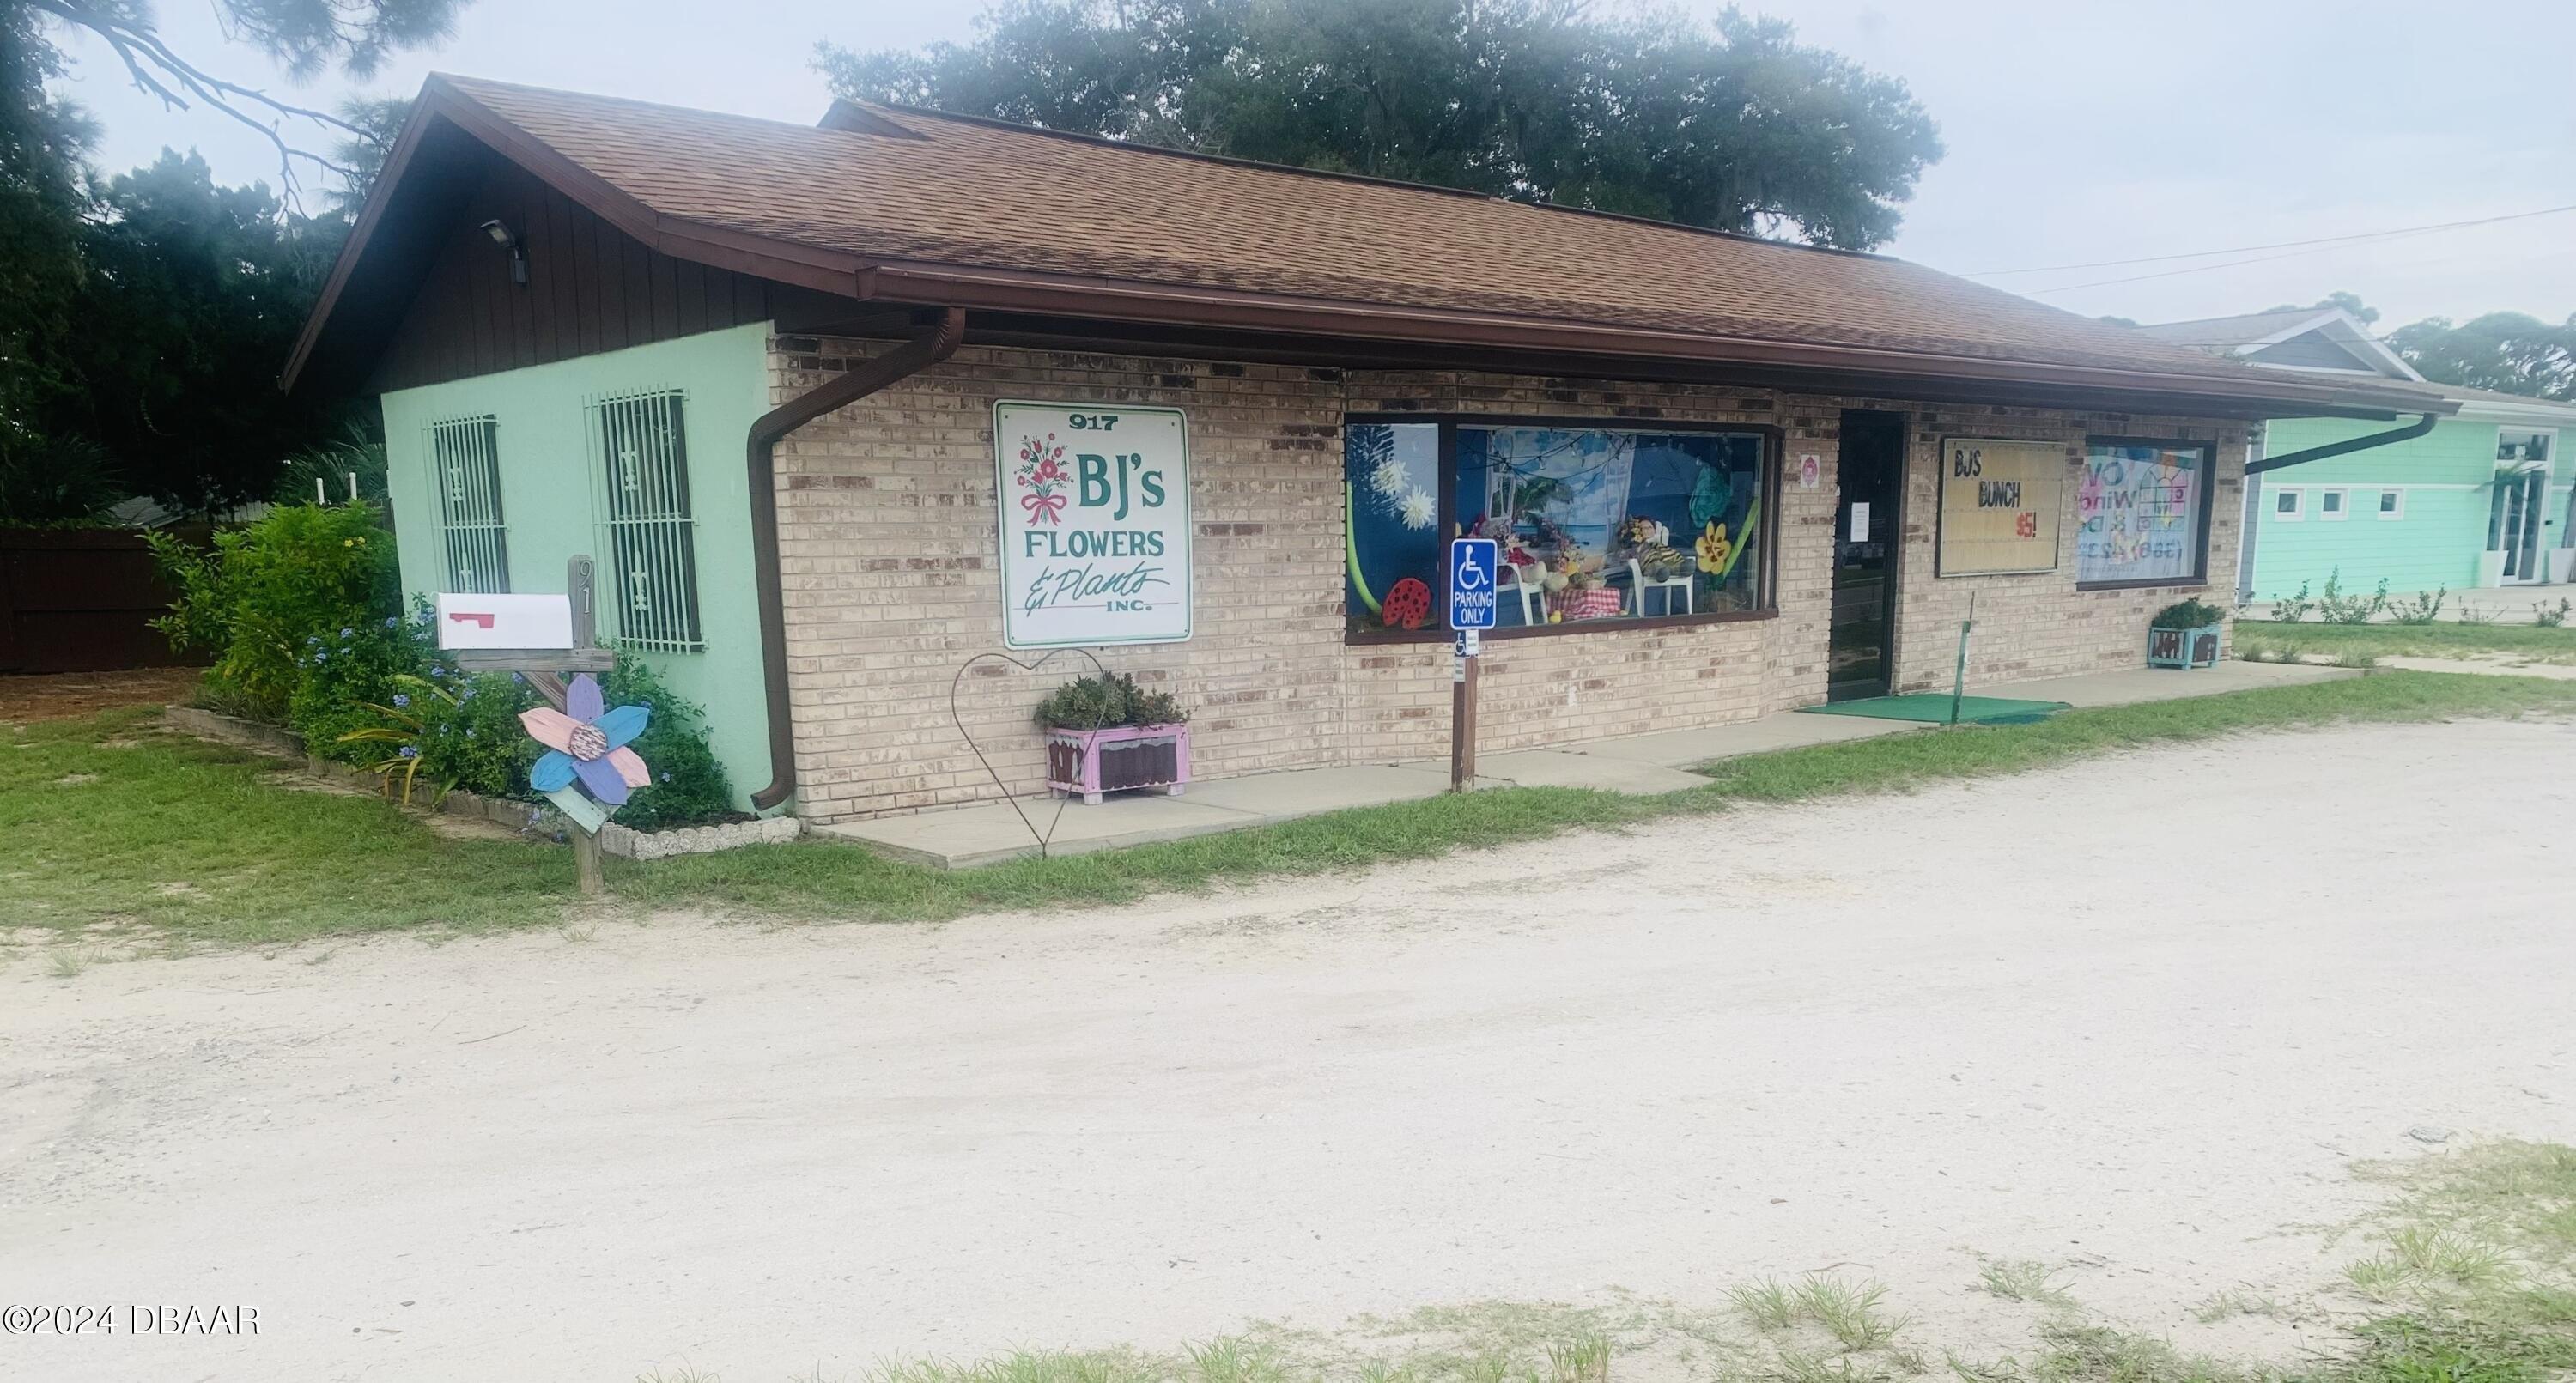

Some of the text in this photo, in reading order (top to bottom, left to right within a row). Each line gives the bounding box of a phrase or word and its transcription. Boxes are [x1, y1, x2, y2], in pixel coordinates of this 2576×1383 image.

[1069, 414, 1118, 431] 917
[1954, 450, 1982, 477] BJS
[1076, 453, 1166, 521] BJ's
[1978, 481, 2020, 508] BUNCH
[2016, 512, 2037, 538] $5!
[1024, 531, 1164, 558] FLOWERS
[1024, 561, 1170, 617] & Plants
[1454, 591, 1492, 608] PARKING
[1106, 600, 1153, 612] INC.
[1461, 608, 1485, 624] ONLY
